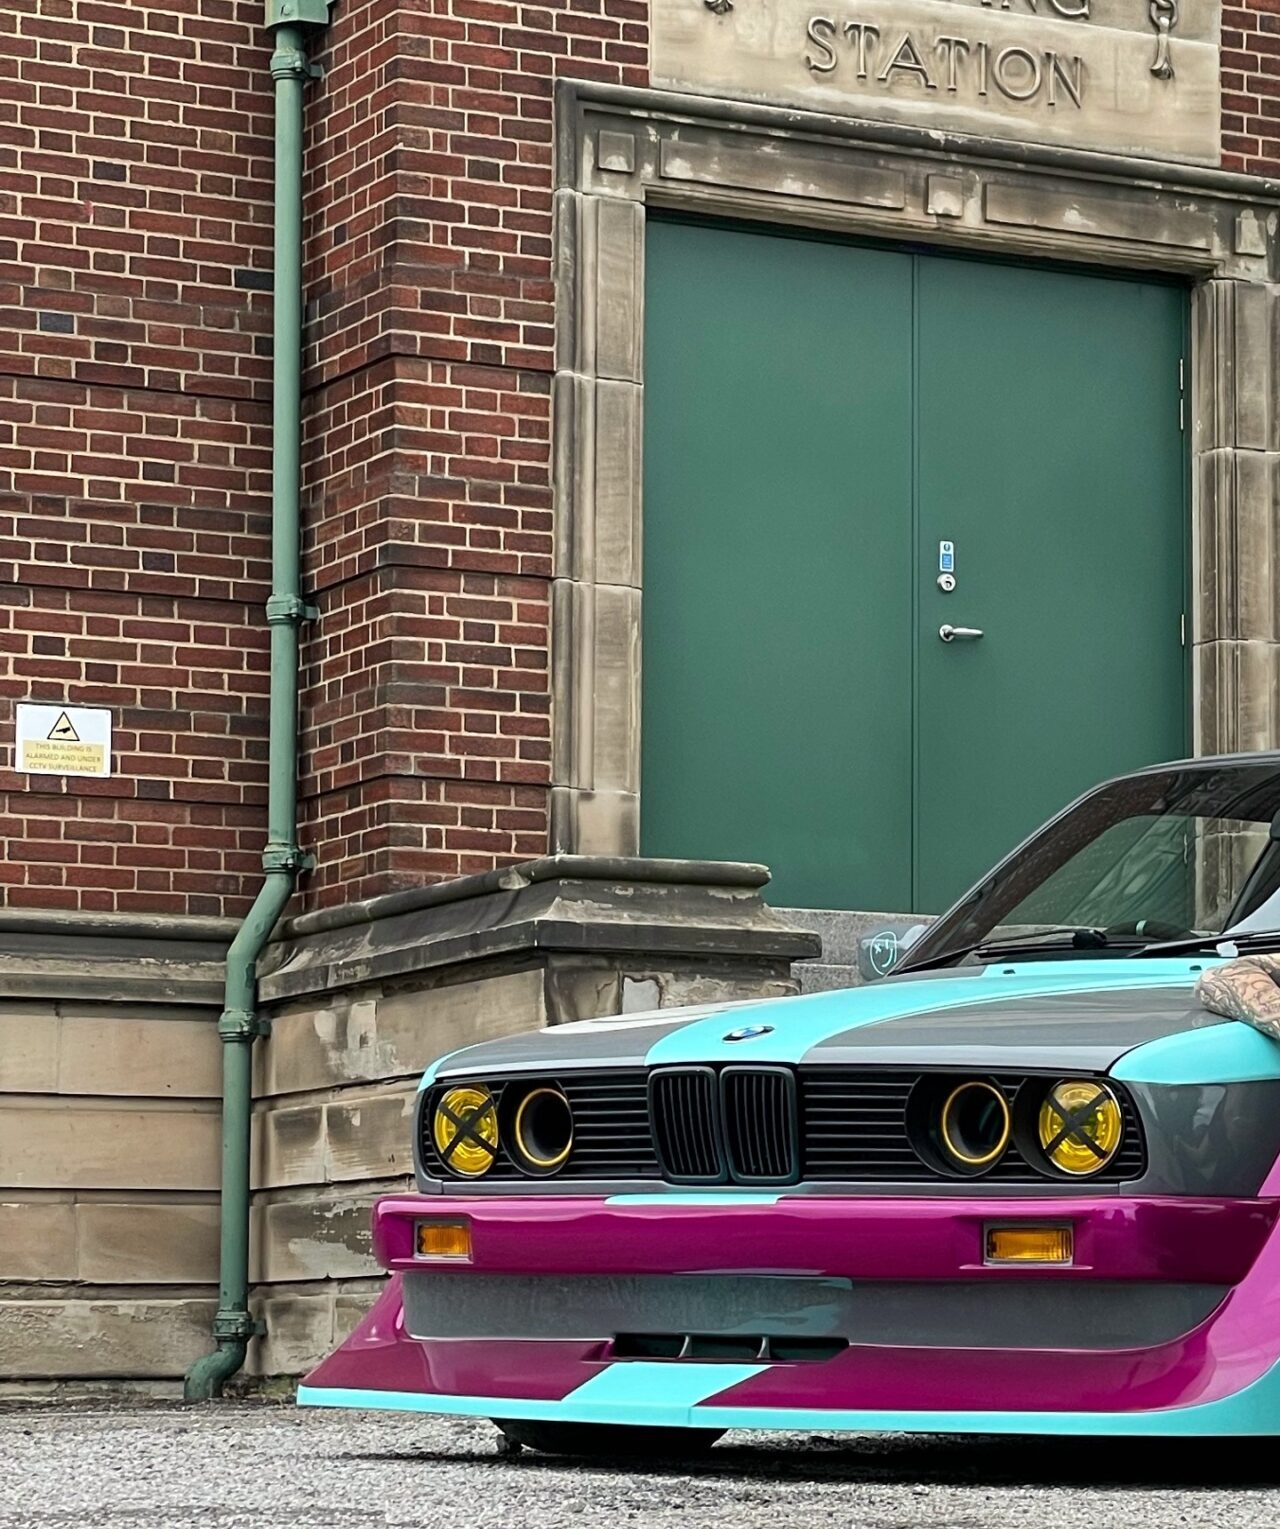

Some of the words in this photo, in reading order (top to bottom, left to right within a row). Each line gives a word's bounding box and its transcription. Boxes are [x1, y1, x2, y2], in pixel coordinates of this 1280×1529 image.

[805, 15, 1084, 110] STATION
[52, 744, 84, 753] BUILDING
[26, 752, 59, 761] ALARMED
[61, 754, 76, 762] AND
[48, 763, 97, 773] SURVEILLANCE
